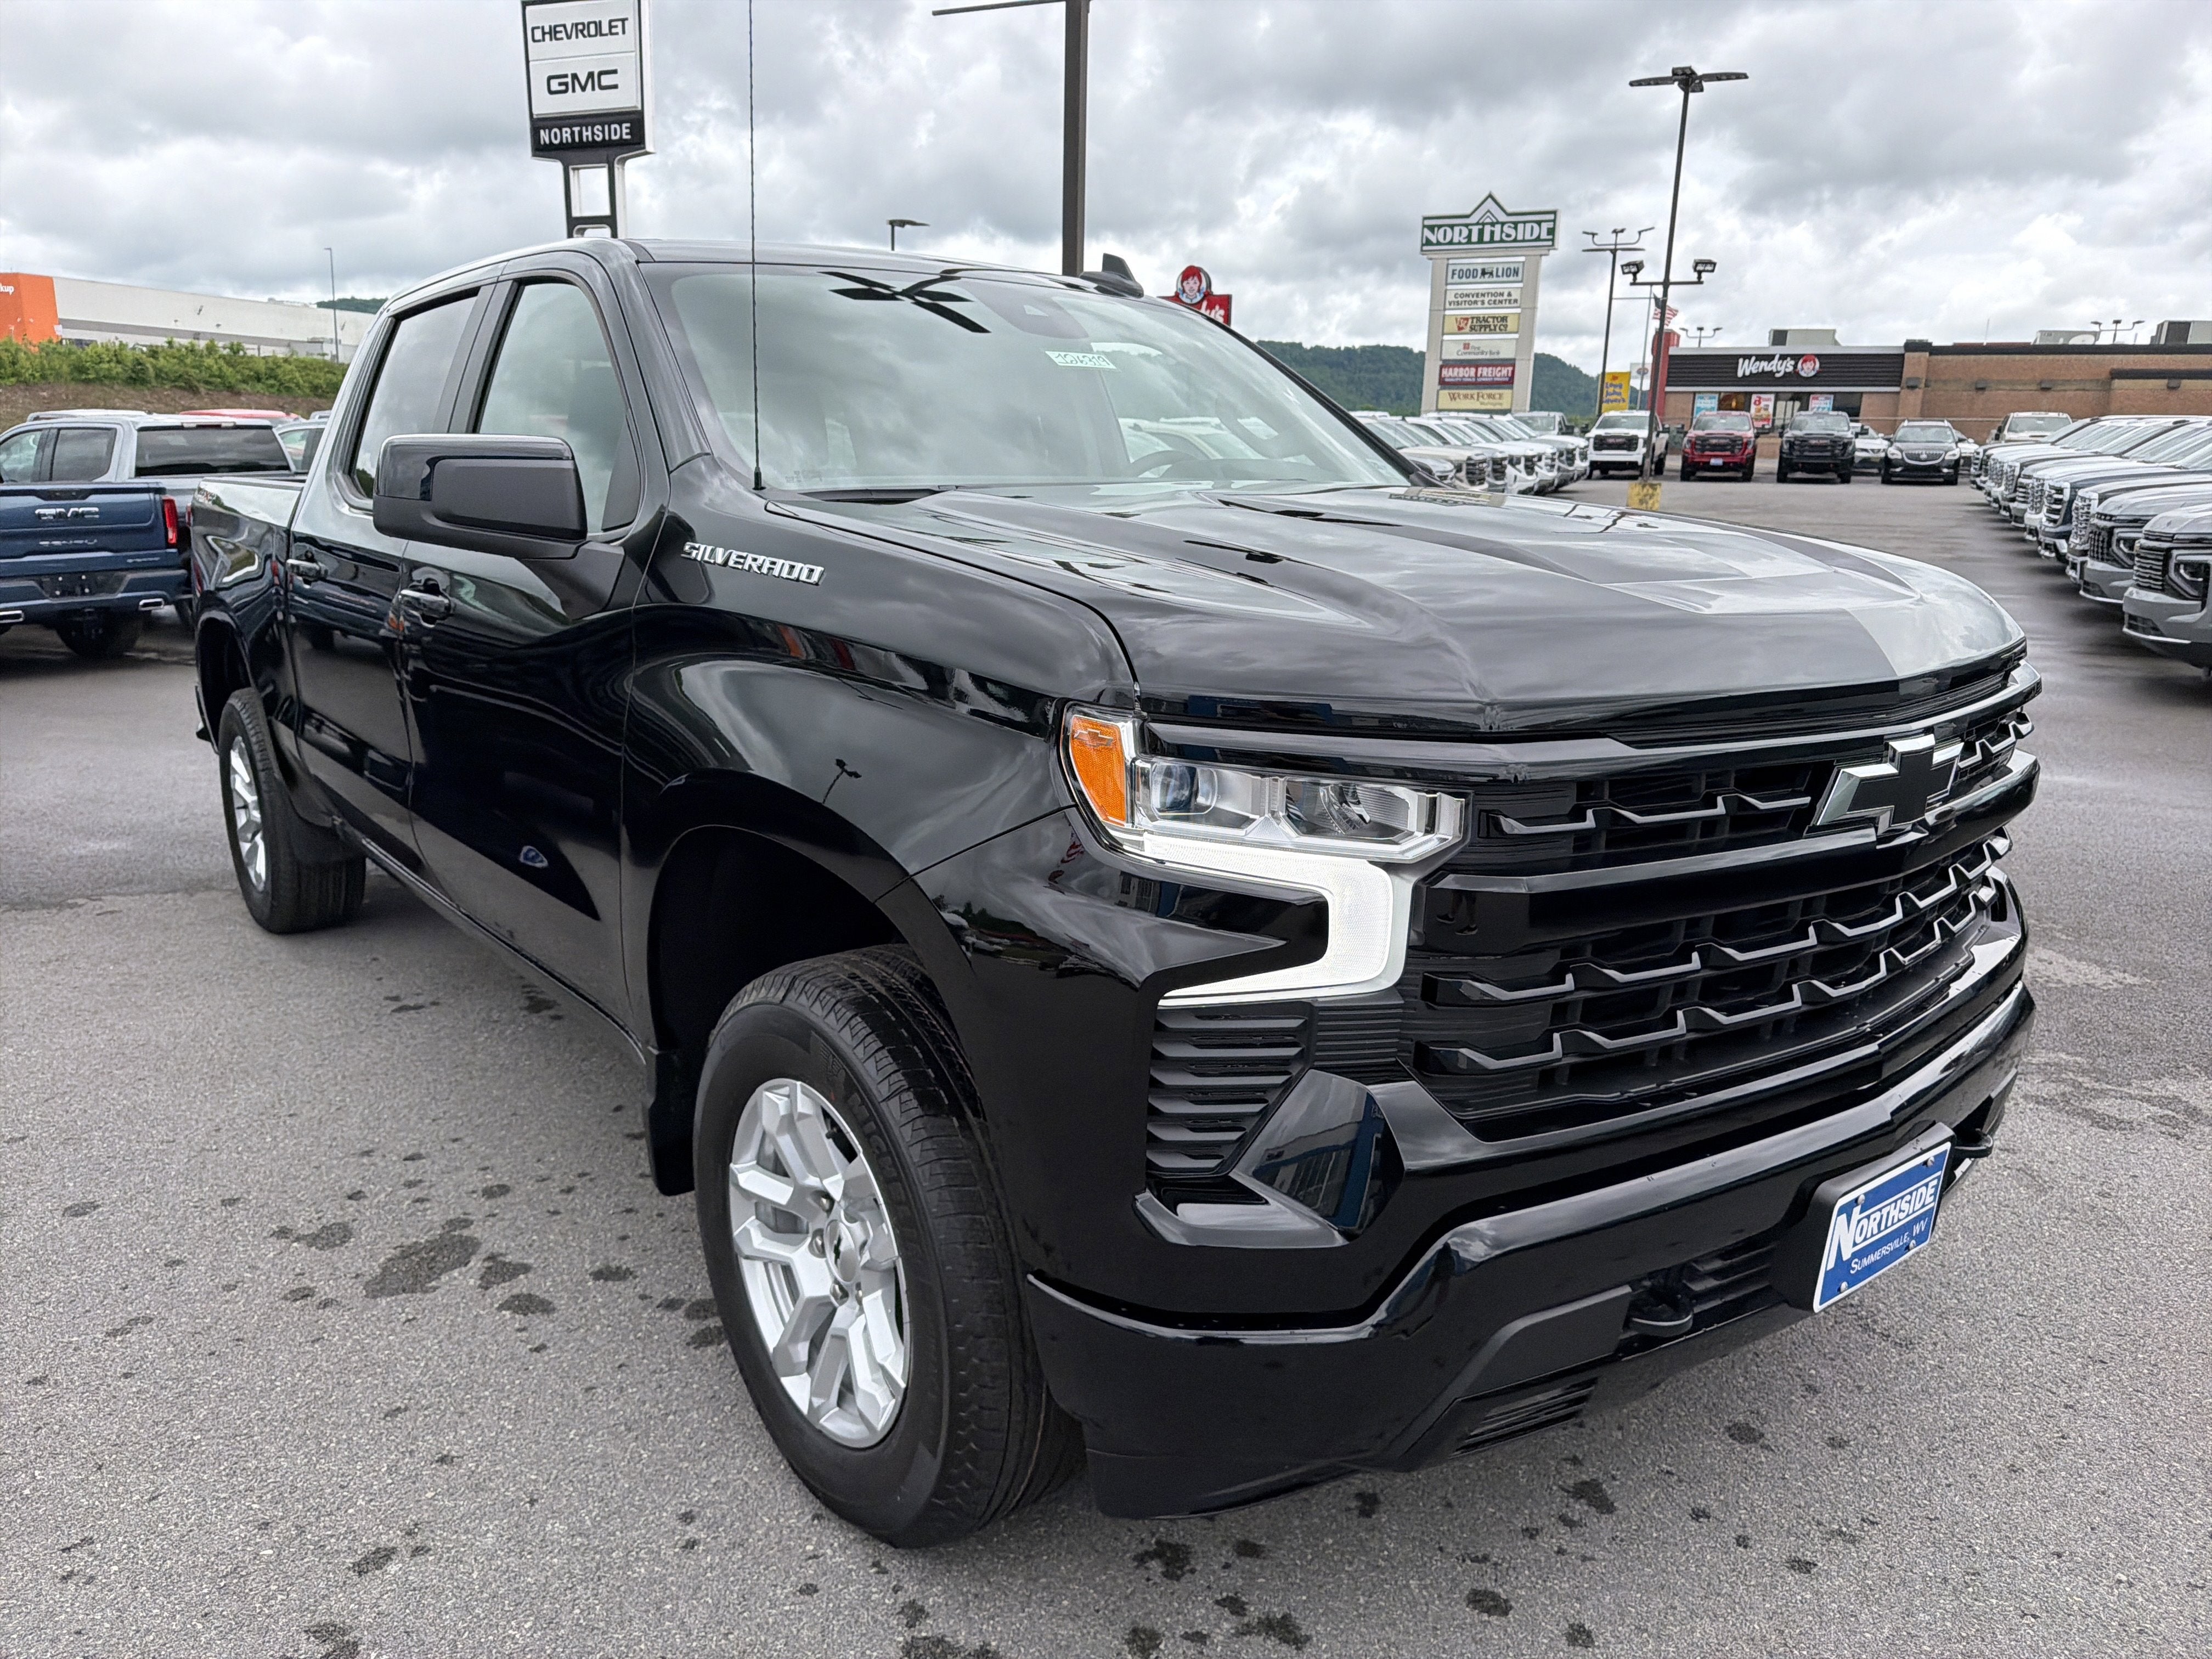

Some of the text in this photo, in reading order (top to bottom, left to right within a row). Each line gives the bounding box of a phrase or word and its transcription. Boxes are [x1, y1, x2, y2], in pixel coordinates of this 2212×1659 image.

[531, 18, 629, 43] CHEVROLET
[546, 69, 619, 95] GMC
[540, 123, 631, 145] NORTHSIDE
[1423, 222, 1554, 244] NORTHSIDE
[1451, 267, 1519, 279] FOOD LION
[1055, 353, 1110, 366] 126319
[1737, 353, 1795, 377] Wendy's
[1442, 366, 1514, 377] HARBOR FREIGHT
[35, 507, 99, 520] GMC
[680, 541, 825, 585] SILVERADO
[1826, 1178, 1938, 1271] NORTHSIDE
[1850, 1217, 1929, 1274] SUMMERSVILLE, WV
